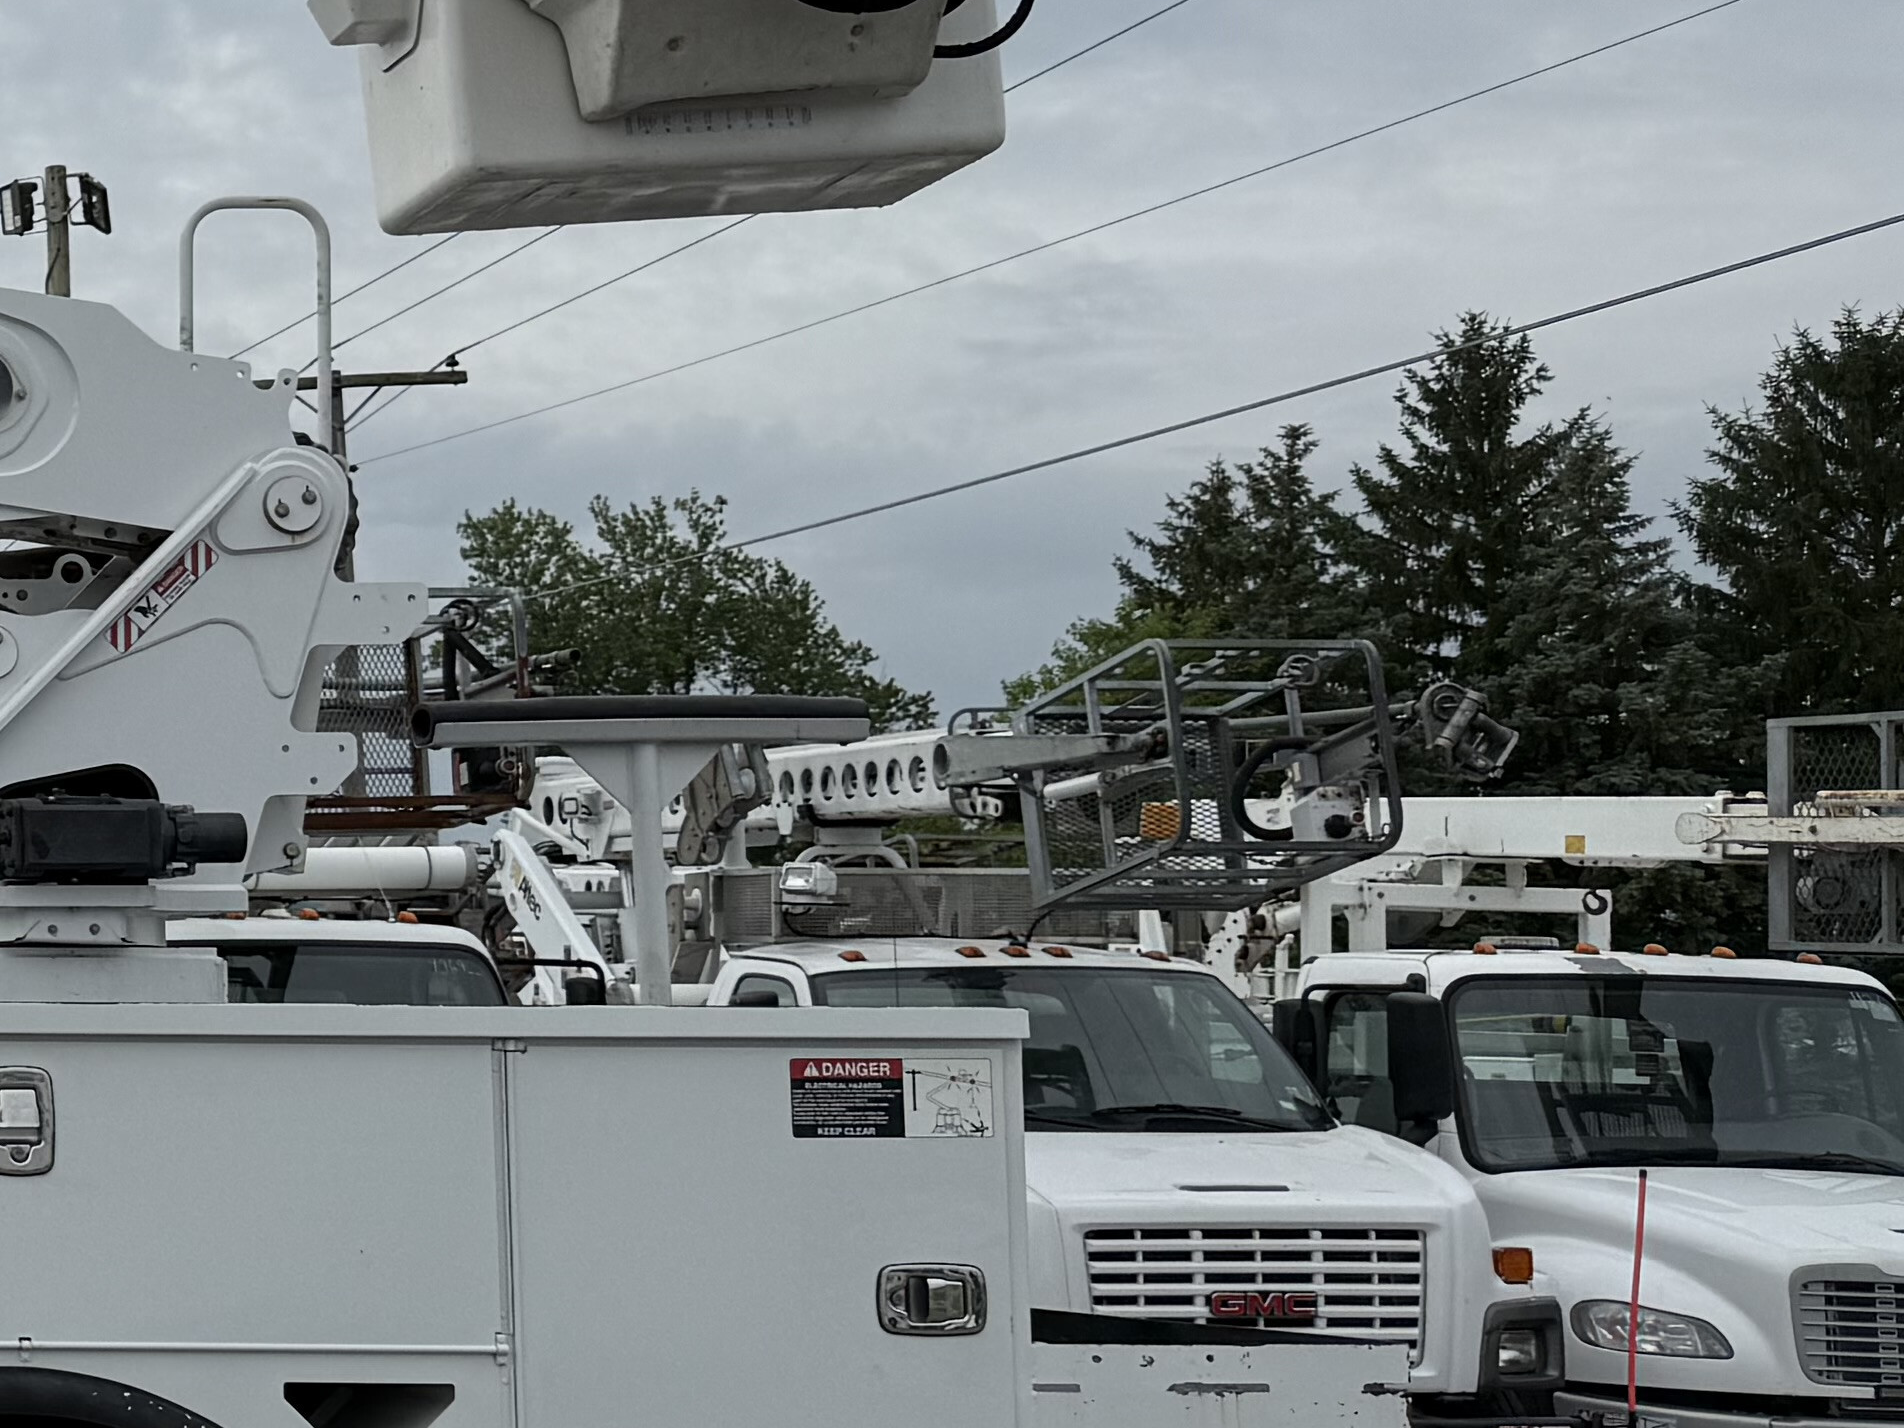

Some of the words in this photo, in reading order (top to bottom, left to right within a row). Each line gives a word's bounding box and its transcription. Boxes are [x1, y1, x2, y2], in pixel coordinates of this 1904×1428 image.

[821, 1062, 890, 1077] DANGER
[817, 1127, 842, 1135] KEEP
[844, 1127, 876, 1135] CLEAR
[1211, 1292, 1317, 1317] GMC
